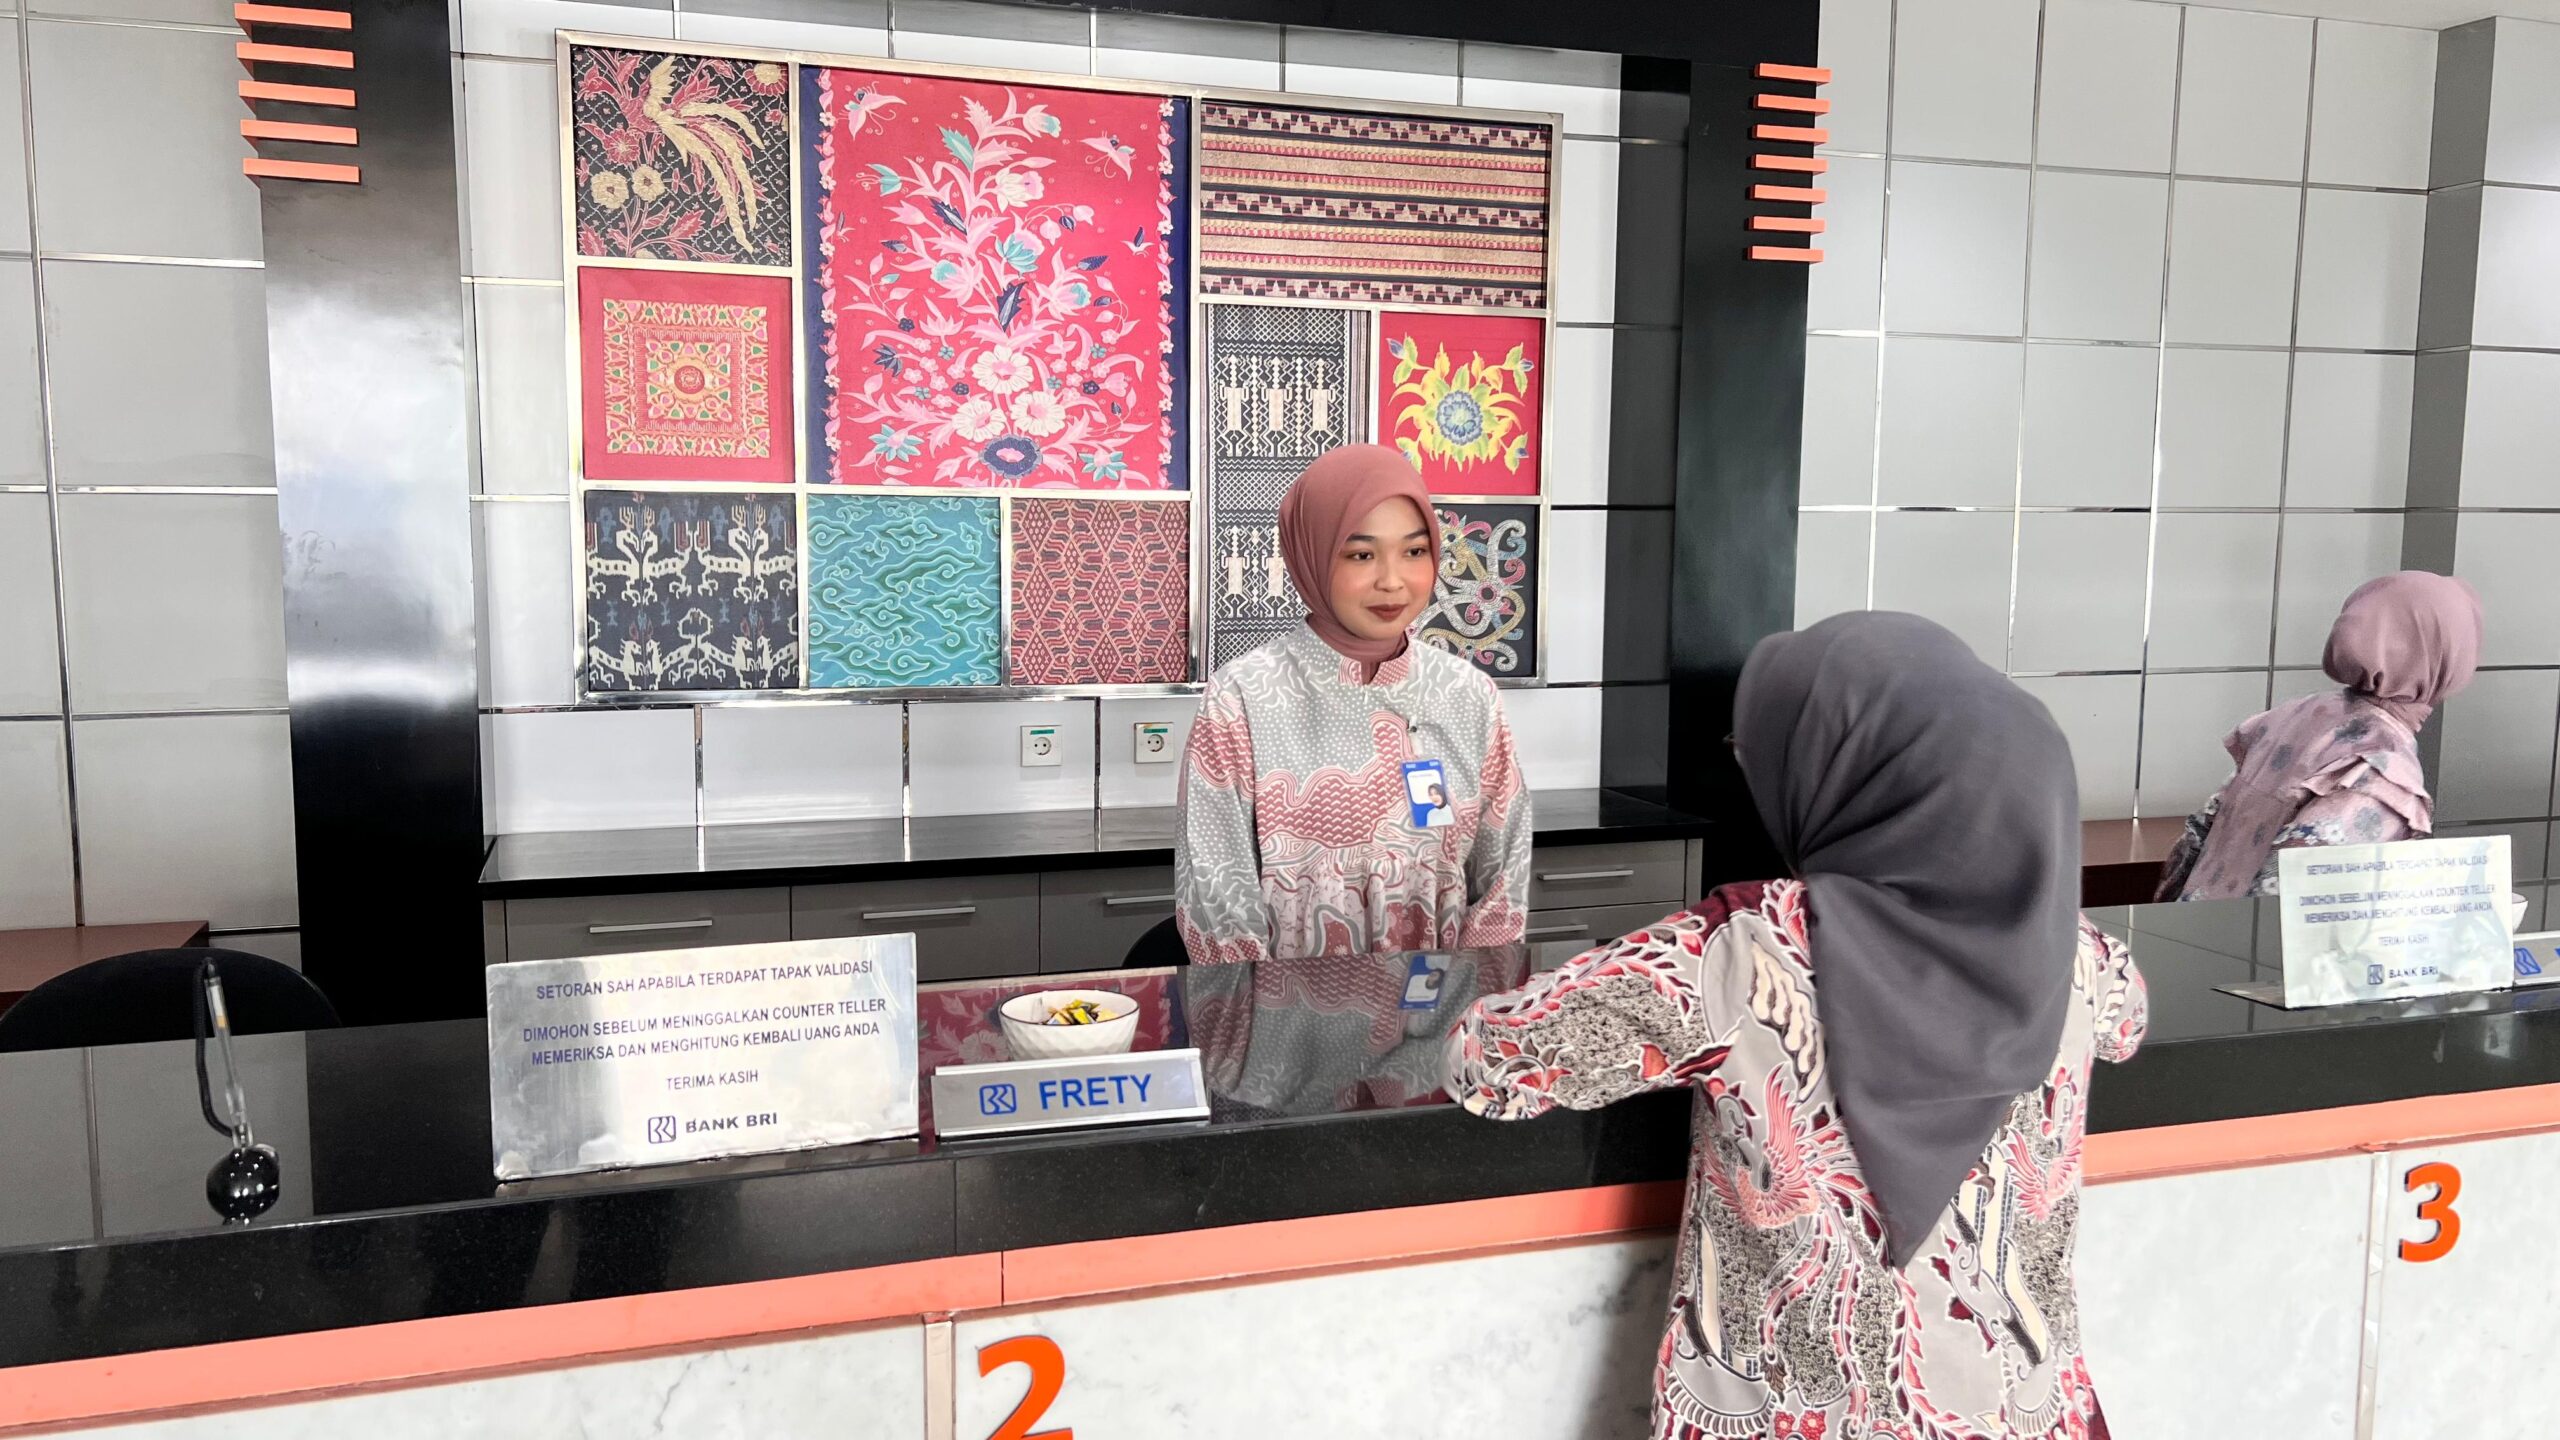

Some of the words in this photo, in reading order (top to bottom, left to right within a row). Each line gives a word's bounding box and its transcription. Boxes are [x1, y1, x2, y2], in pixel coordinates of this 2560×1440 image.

[536, 981, 603, 1000] SETORAN
[606, 978, 635, 994] SAH
[638, 973, 695, 991] APABILA
[699, 968, 767, 986] TERDAPAT
[771, 964, 813, 980] TAPAK
[816, 959, 873, 977] VALIDASI
[2388, 967, 2418, 979] BANK
[2421, 966, 2439, 976] BRI
[522, 1023, 589, 1042] DIMOHON
[593, 1018, 658, 1036] SEBELUM
[662, 1008, 769, 1029] MENINGGALKAN
[772, 1002, 834, 1020] COUNTER
[838, 998, 887, 1014] TELLER
[532, 1046, 615, 1066] MEMERIKSA
[618, 1042, 646, 1058] DAN
[650, 1034, 739, 1055] MENGHITUNG
[743, 1028, 801, 1046] KEMBALI
[804, 1025, 841, 1041] UANG
[844, 1021, 880, 1037] ANDA
[667, 1073, 716, 1091] TERIMA
[719, 1069, 759, 1086] KASIH
[1038, 1073, 1152, 1111] FRETY
[685, 1116, 739, 1134] BANK
[746, 1112, 778, 1128] BRI
[2397, 1161, 2462, 1263] 3
[977, 1334, 1074, 1440] 2
